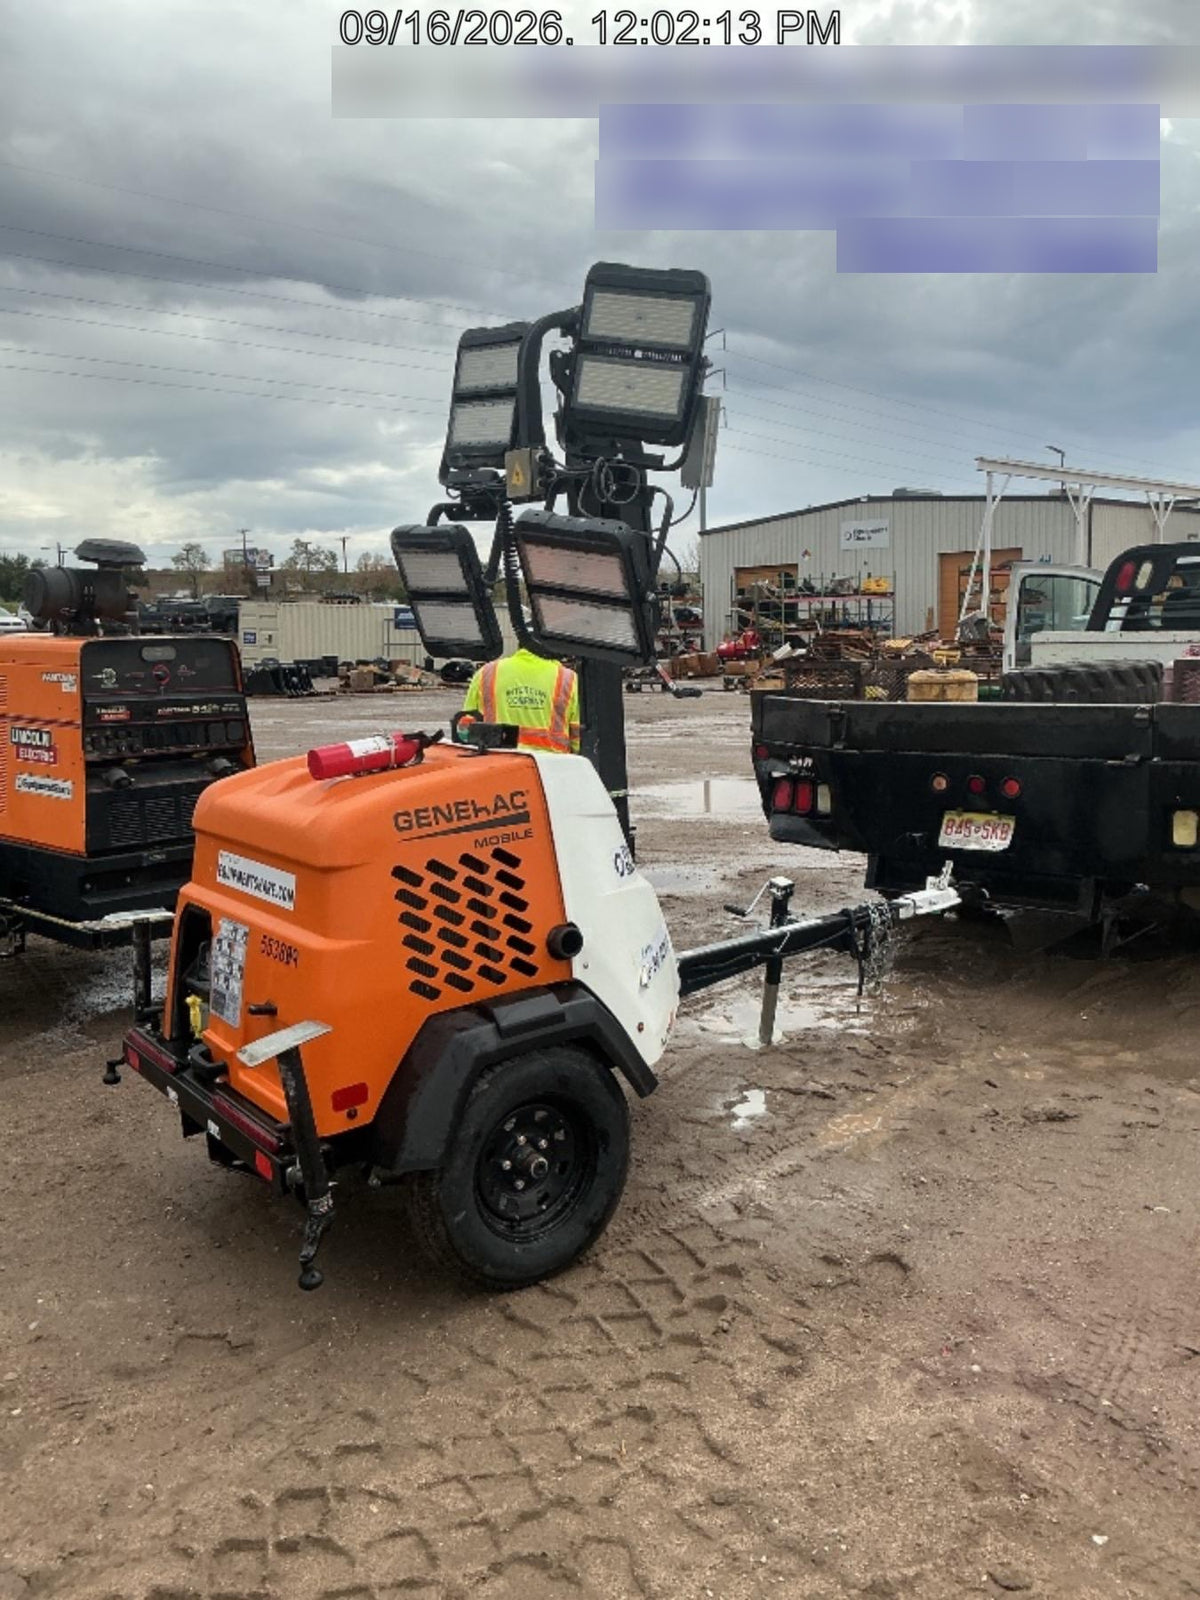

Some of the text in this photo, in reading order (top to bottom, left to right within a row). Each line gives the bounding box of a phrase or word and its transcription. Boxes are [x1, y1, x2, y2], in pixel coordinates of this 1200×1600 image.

[11, 729, 50, 748] LINCOLN
[19, 747, 54, 762] ELECTRIC
[393, 790, 528, 832] GENERAC
[474, 828, 534, 849] MOBILE
